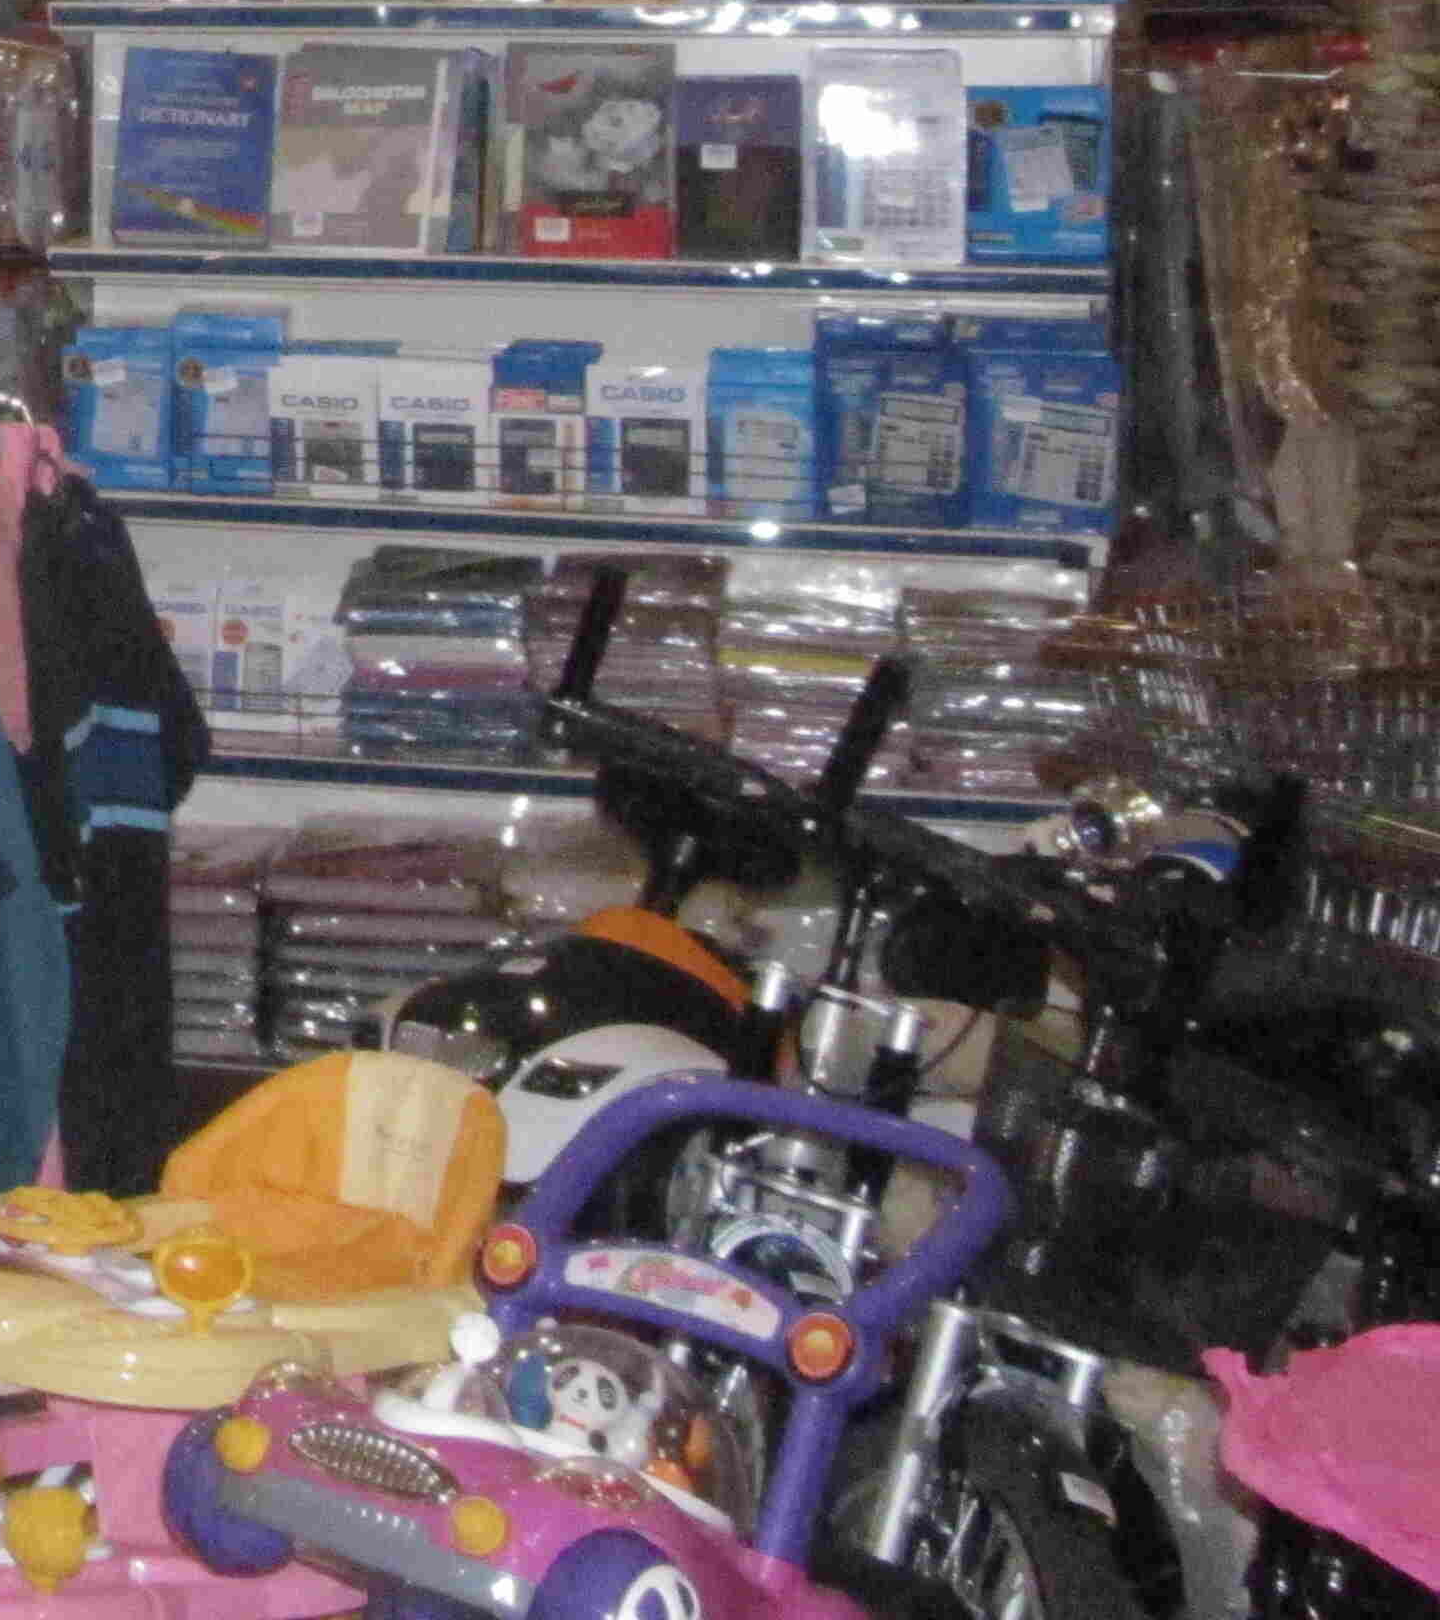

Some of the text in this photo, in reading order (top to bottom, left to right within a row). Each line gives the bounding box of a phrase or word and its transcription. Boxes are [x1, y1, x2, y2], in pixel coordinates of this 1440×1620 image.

[280, 393, 360, 412] CASIO
[390, 395, 472, 412] CASIO
[600, 384, 688, 404] CASIO
